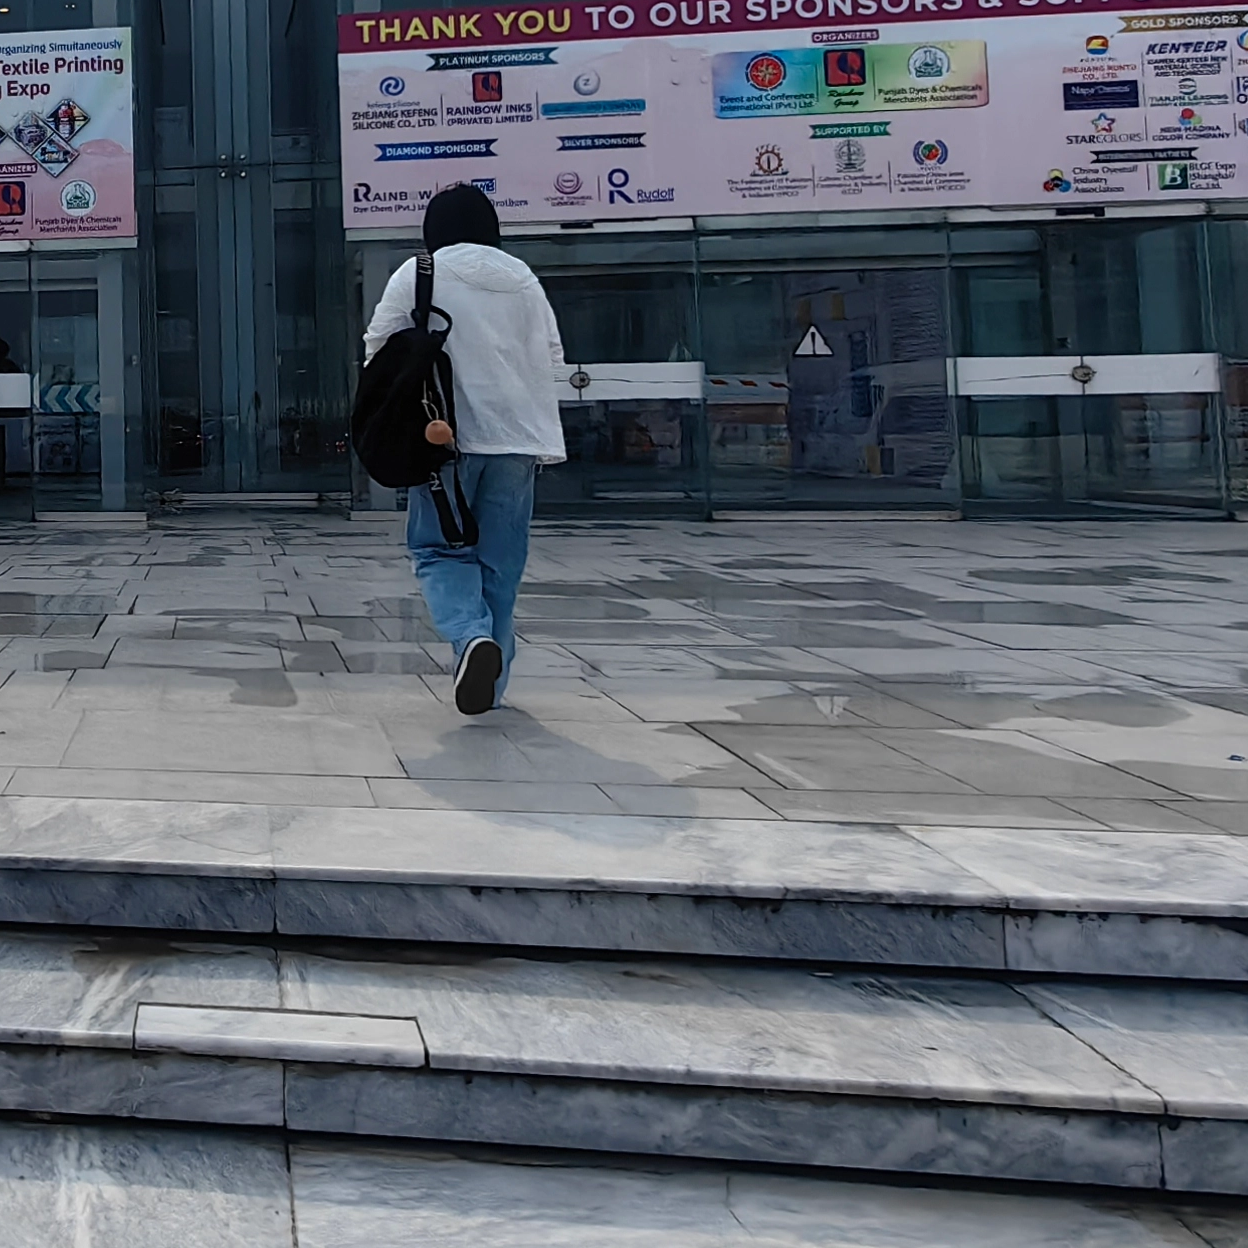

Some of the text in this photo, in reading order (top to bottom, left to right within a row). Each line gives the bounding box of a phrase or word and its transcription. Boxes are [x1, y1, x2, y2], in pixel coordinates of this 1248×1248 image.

[355, 13, 482, 44] THANK
[494, 7, 572, 36] YOU
[584, 4, 635, 31] TO
[1131, 14, 1239, 30] GOLD SPONSORS
[813, 31, 879, 42] ORGANIZERS
[48, 39, 123, 53] Simultaneously
[54, 55, 124, 75] Printing
[439, 52, 546, 67] PLATINUM SPONSORS
[6, 80, 51, 100] Expo
[352, 107, 438, 121] ZHEJIANG KEFENG
[446, 104, 502, 116] RAINBOW
[505, 102, 533, 113] INKS
[352, 119, 395, 131] SILICONE
[447, 116, 493, 127] (PRIVATE)
[495, 114, 534, 124] LIMITED
[814, 125, 871, 137] SUPPORTED
[594, 137, 639, 146] SPONSORS
[385, 143, 487, 157] DIAMOND SPONSORS
